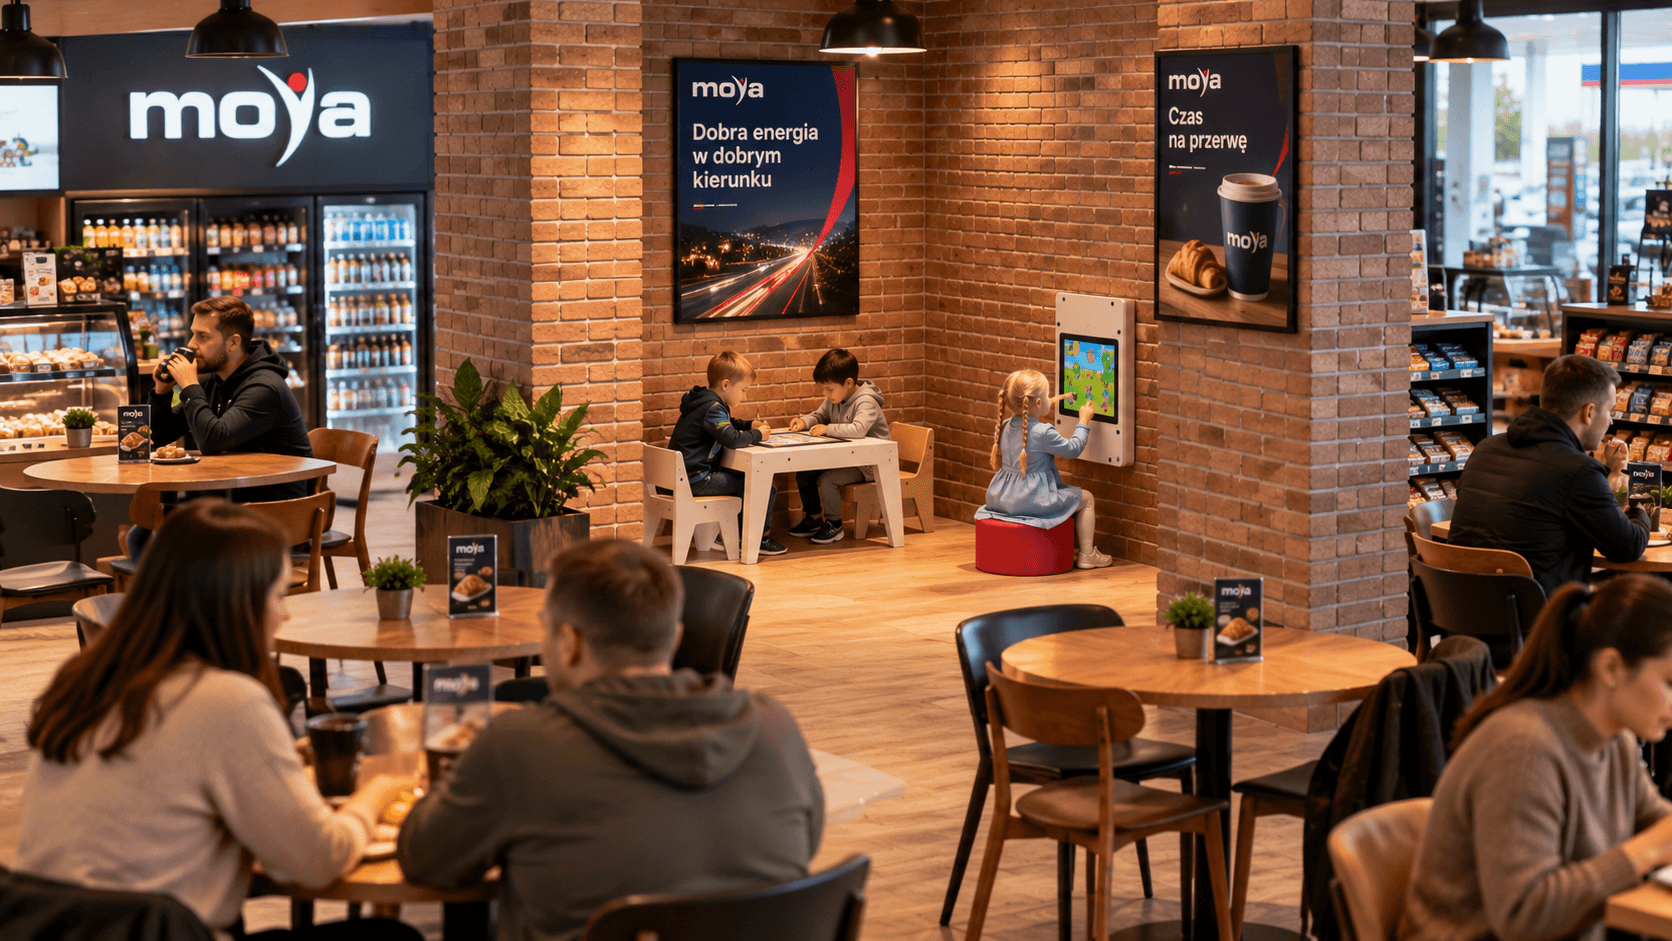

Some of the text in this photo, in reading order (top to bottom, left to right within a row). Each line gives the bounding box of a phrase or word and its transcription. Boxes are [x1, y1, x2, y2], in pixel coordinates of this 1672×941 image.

[692, 75, 764, 106] moya
[1168, 67, 1222, 98] moya
[129, 64, 371, 168] moya
[1168, 106, 1204, 125] Czas
[693, 122, 819, 145] Dobra energia
[1168, 133, 1248, 154] na przerwę
[692, 146, 782, 168] w dobrym
[693, 170, 772, 189] kierunku
[1227, 231, 1268, 254] moya
